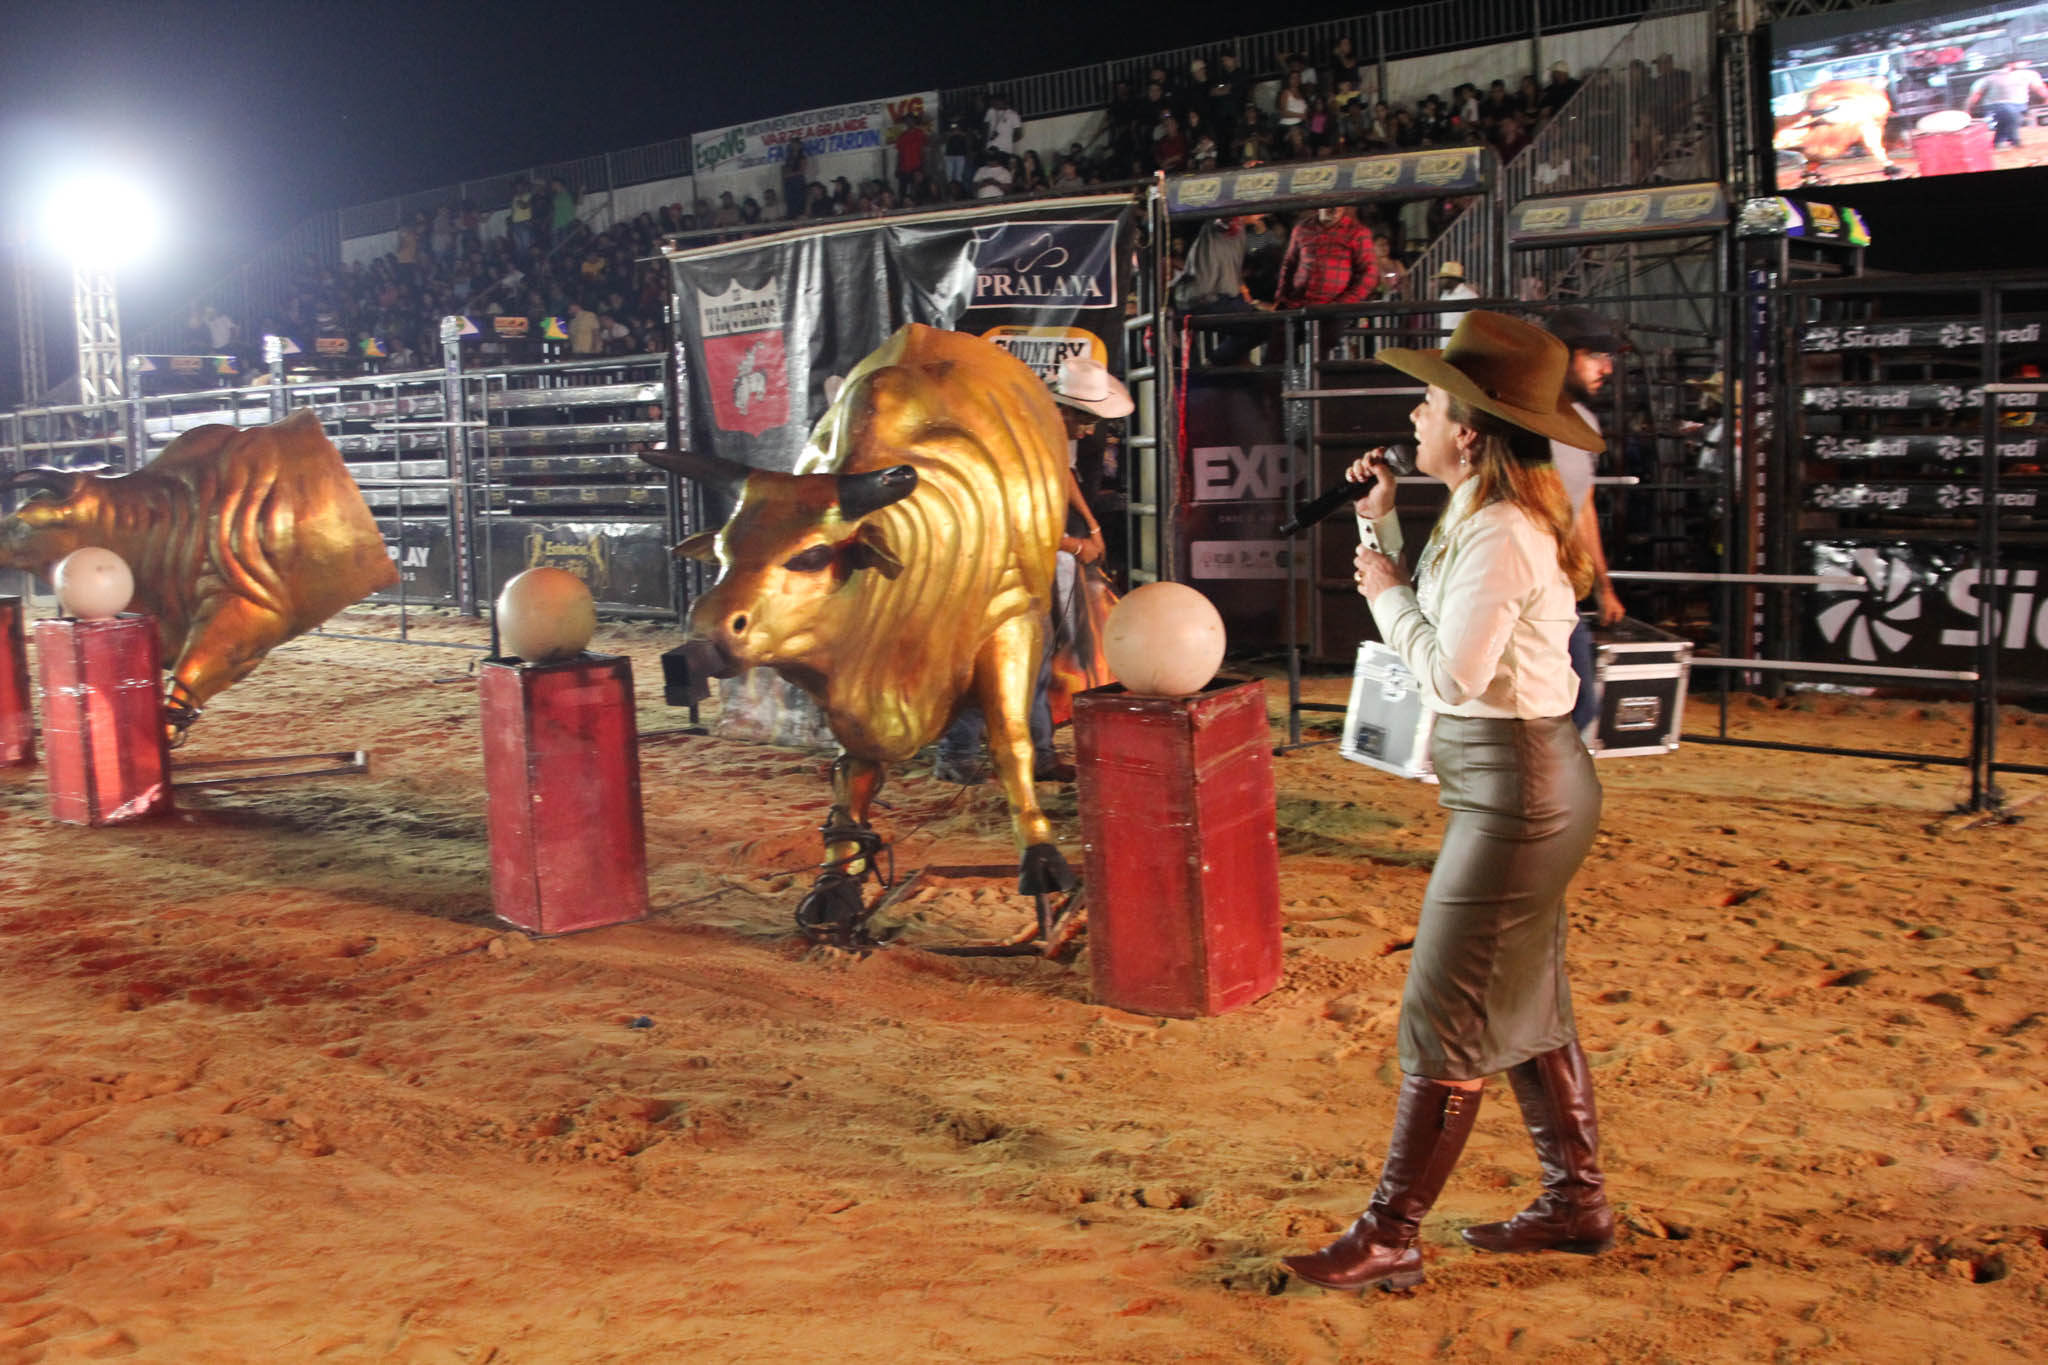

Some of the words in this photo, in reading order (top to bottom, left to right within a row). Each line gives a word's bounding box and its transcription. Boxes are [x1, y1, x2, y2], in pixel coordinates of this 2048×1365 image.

[1843, 328, 1911, 347] Sicredi
[1966, 323, 2041, 345] Siredi
[1842, 390, 1911, 408] Sicredi
[1965, 438, 2038, 457] Siredi
